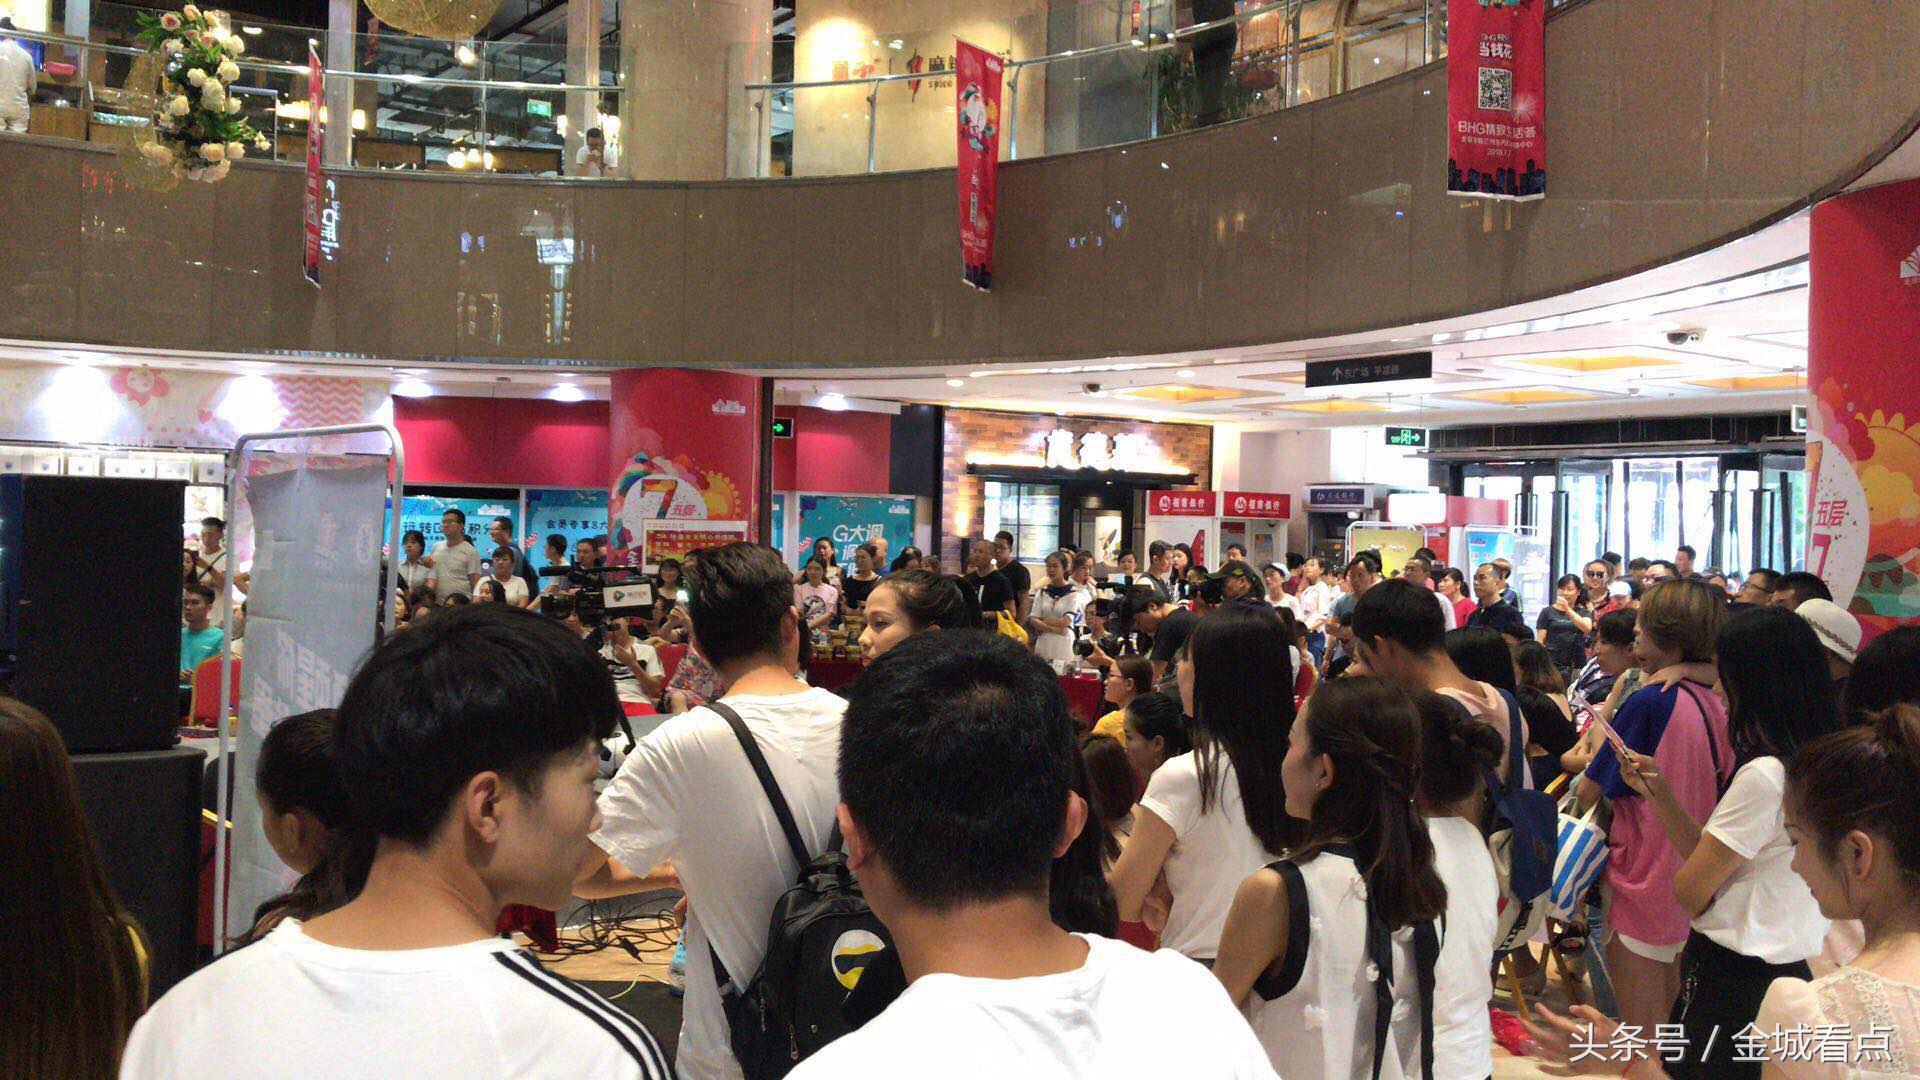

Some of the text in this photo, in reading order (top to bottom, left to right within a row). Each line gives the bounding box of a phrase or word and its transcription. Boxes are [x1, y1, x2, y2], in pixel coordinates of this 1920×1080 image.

[1173, 496, 1205, 509] 招商银行
[1249, 498, 1280, 510] 招商银行
[672, 504, 697, 516] 五层
[1815, 500, 1849, 527] 五层
